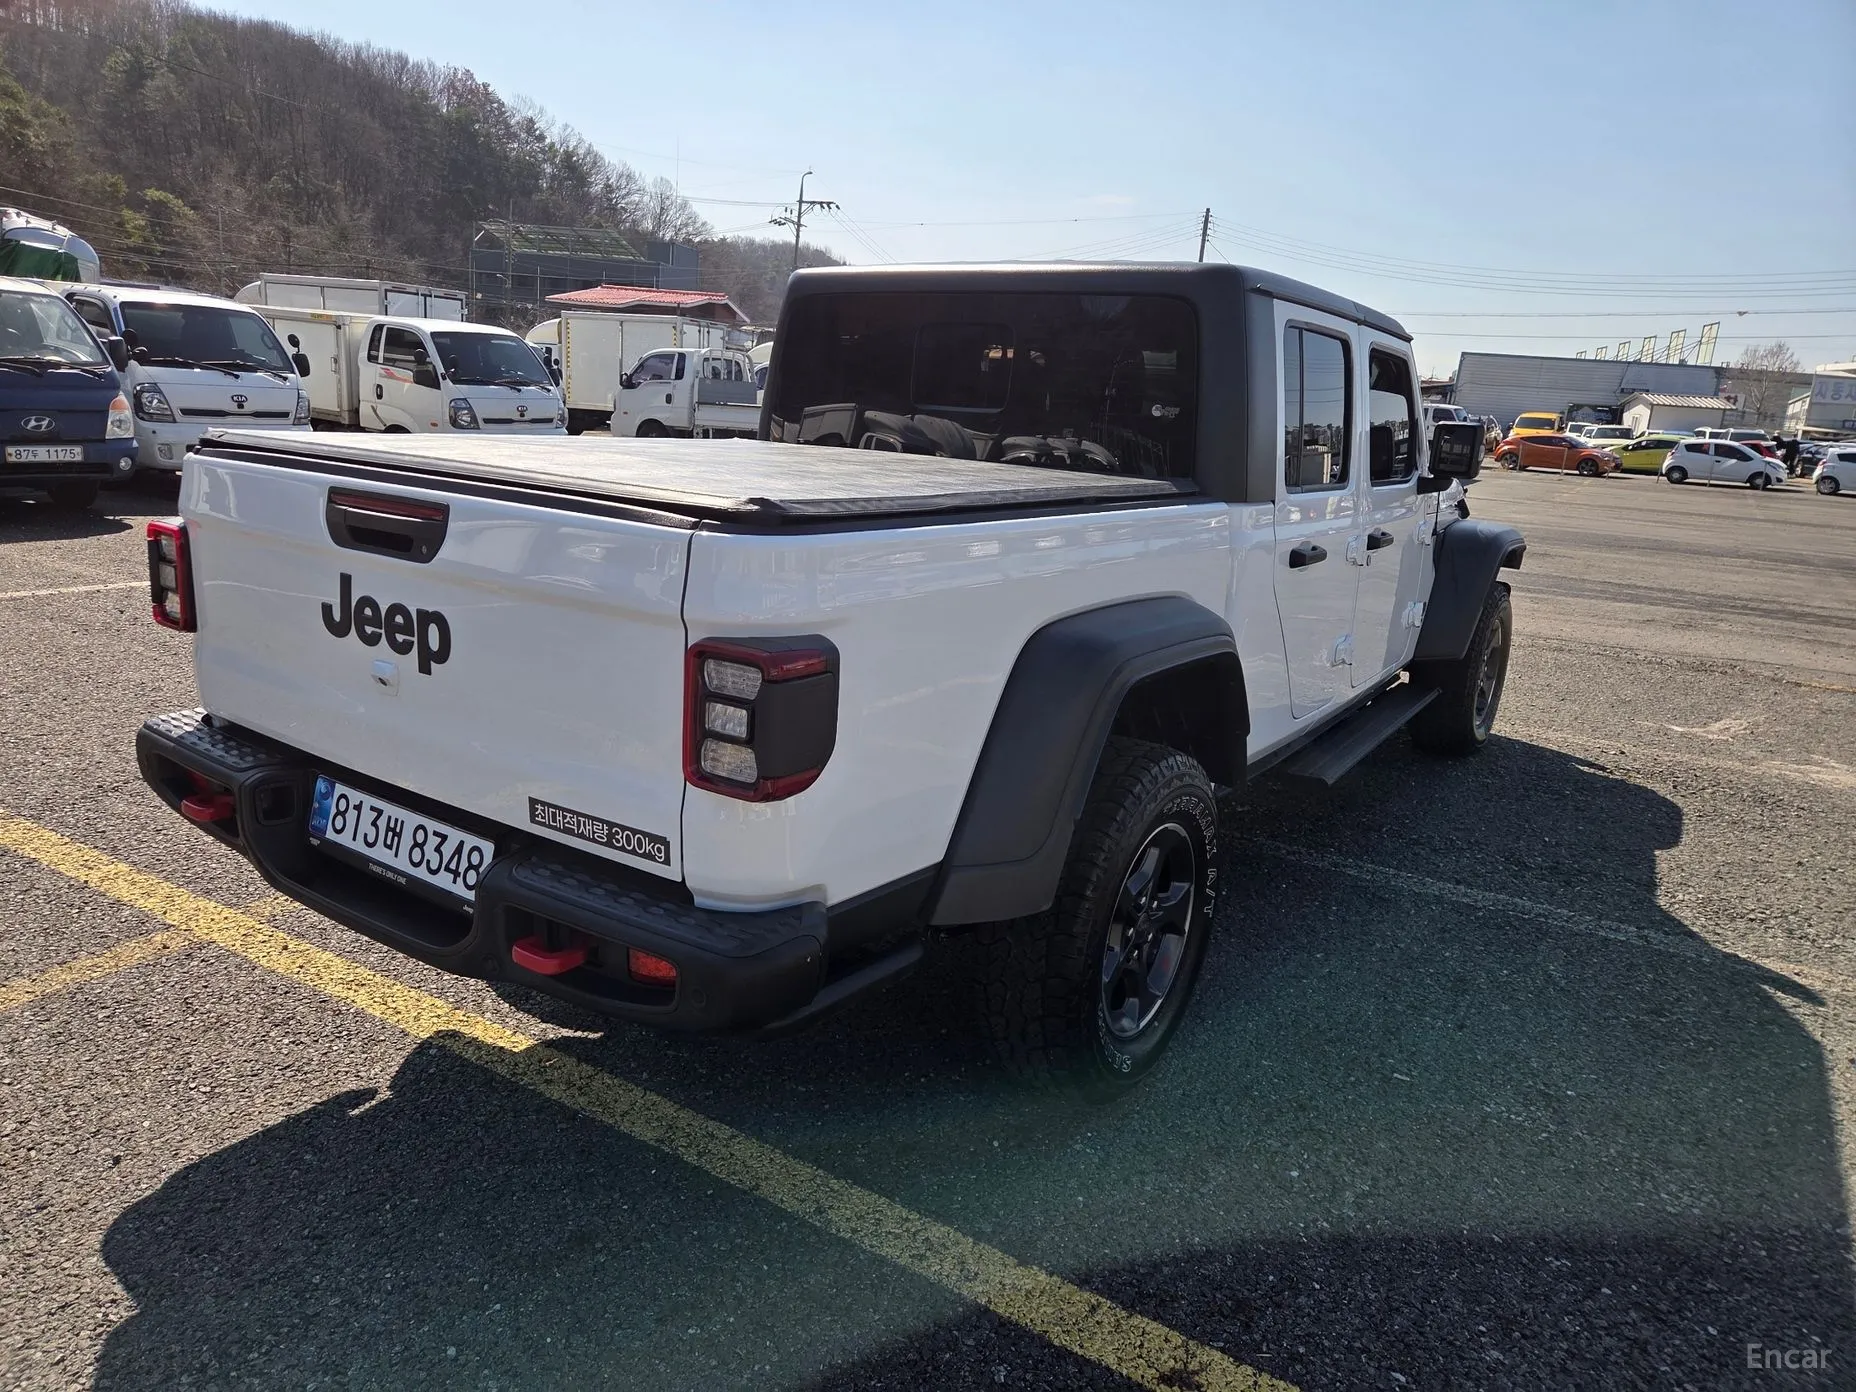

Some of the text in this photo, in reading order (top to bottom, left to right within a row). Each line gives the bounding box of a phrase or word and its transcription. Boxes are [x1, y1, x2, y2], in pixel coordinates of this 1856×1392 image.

[14, 448, 76, 460] 87두 1175
[321, 572, 451, 676] Jeep
[331, 793, 484, 891] 813버 8348
[535, 804, 665, 862] 최대적재량 300kg
[1203, 868, 1218, 918] A/T
